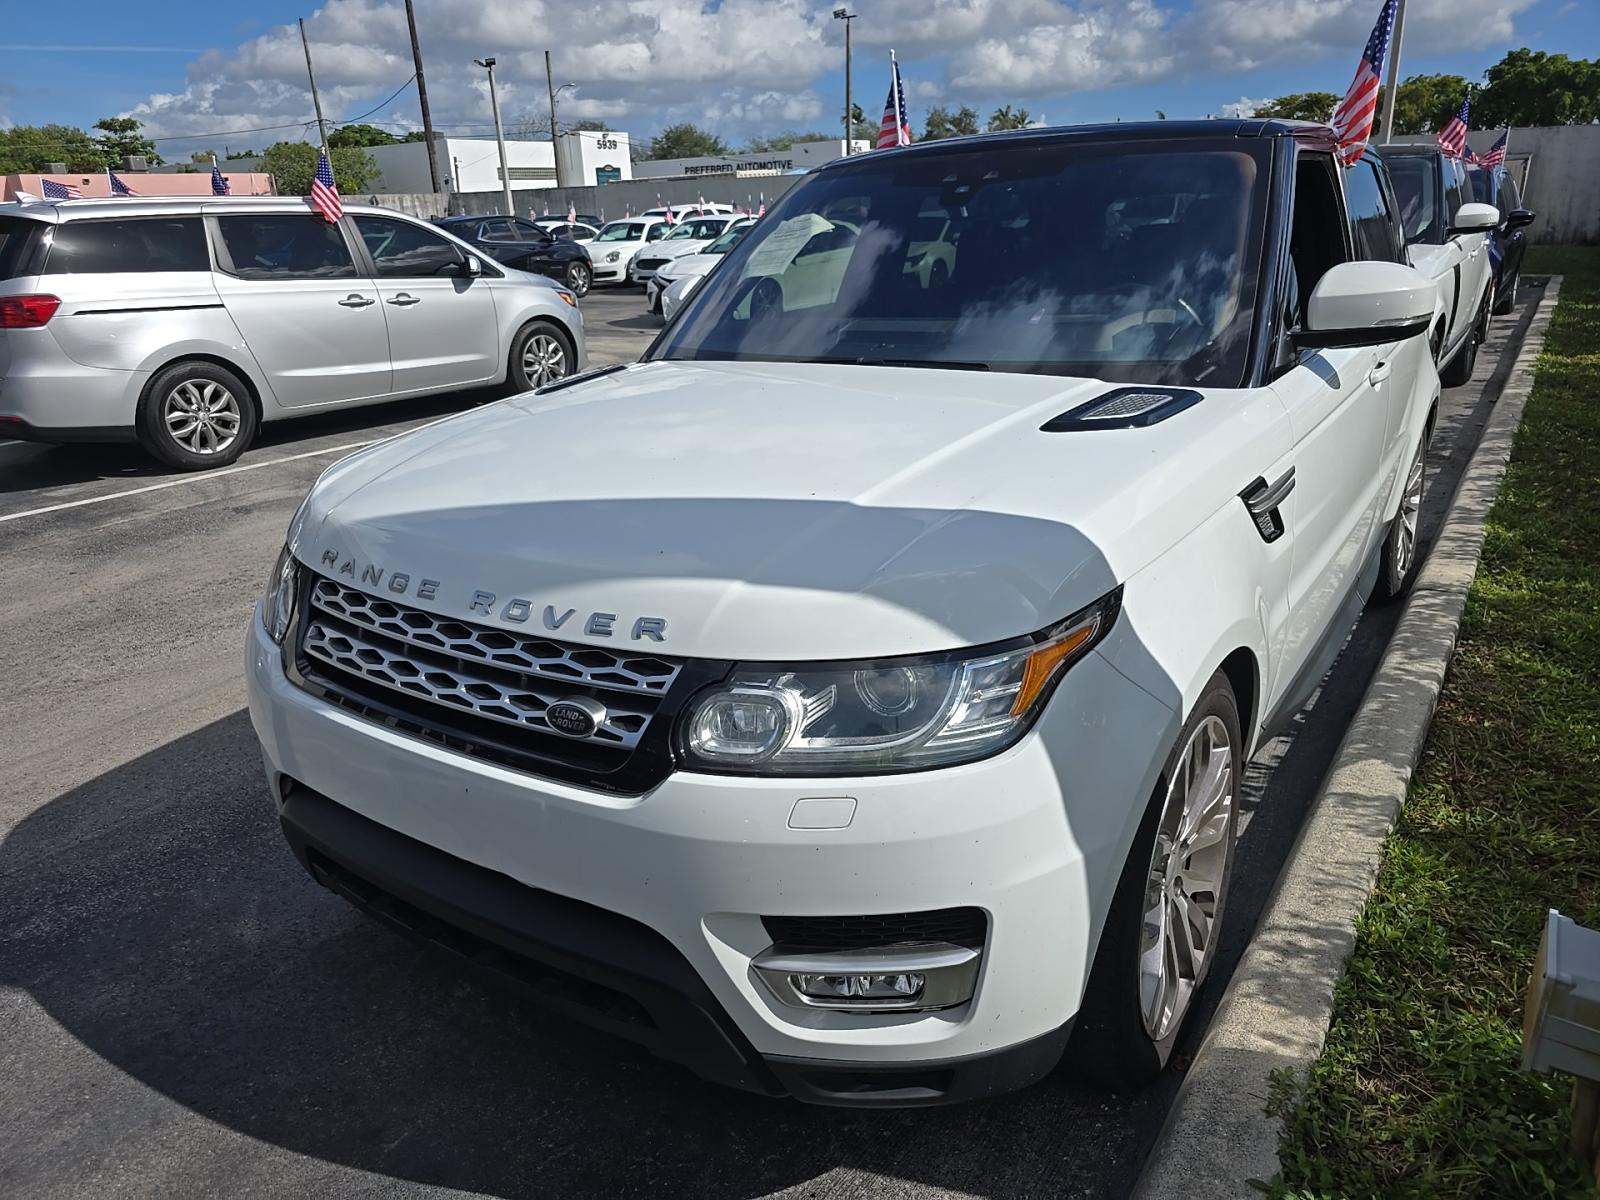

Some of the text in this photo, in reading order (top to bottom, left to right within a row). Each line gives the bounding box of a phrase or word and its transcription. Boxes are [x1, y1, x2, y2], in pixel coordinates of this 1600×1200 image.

[597, 139, 618, 150] 5939
[684, 159, 793, 175] PREFERRED AUTOMOTIVE
[321, 548, 669, 642] RANGE ROVER
